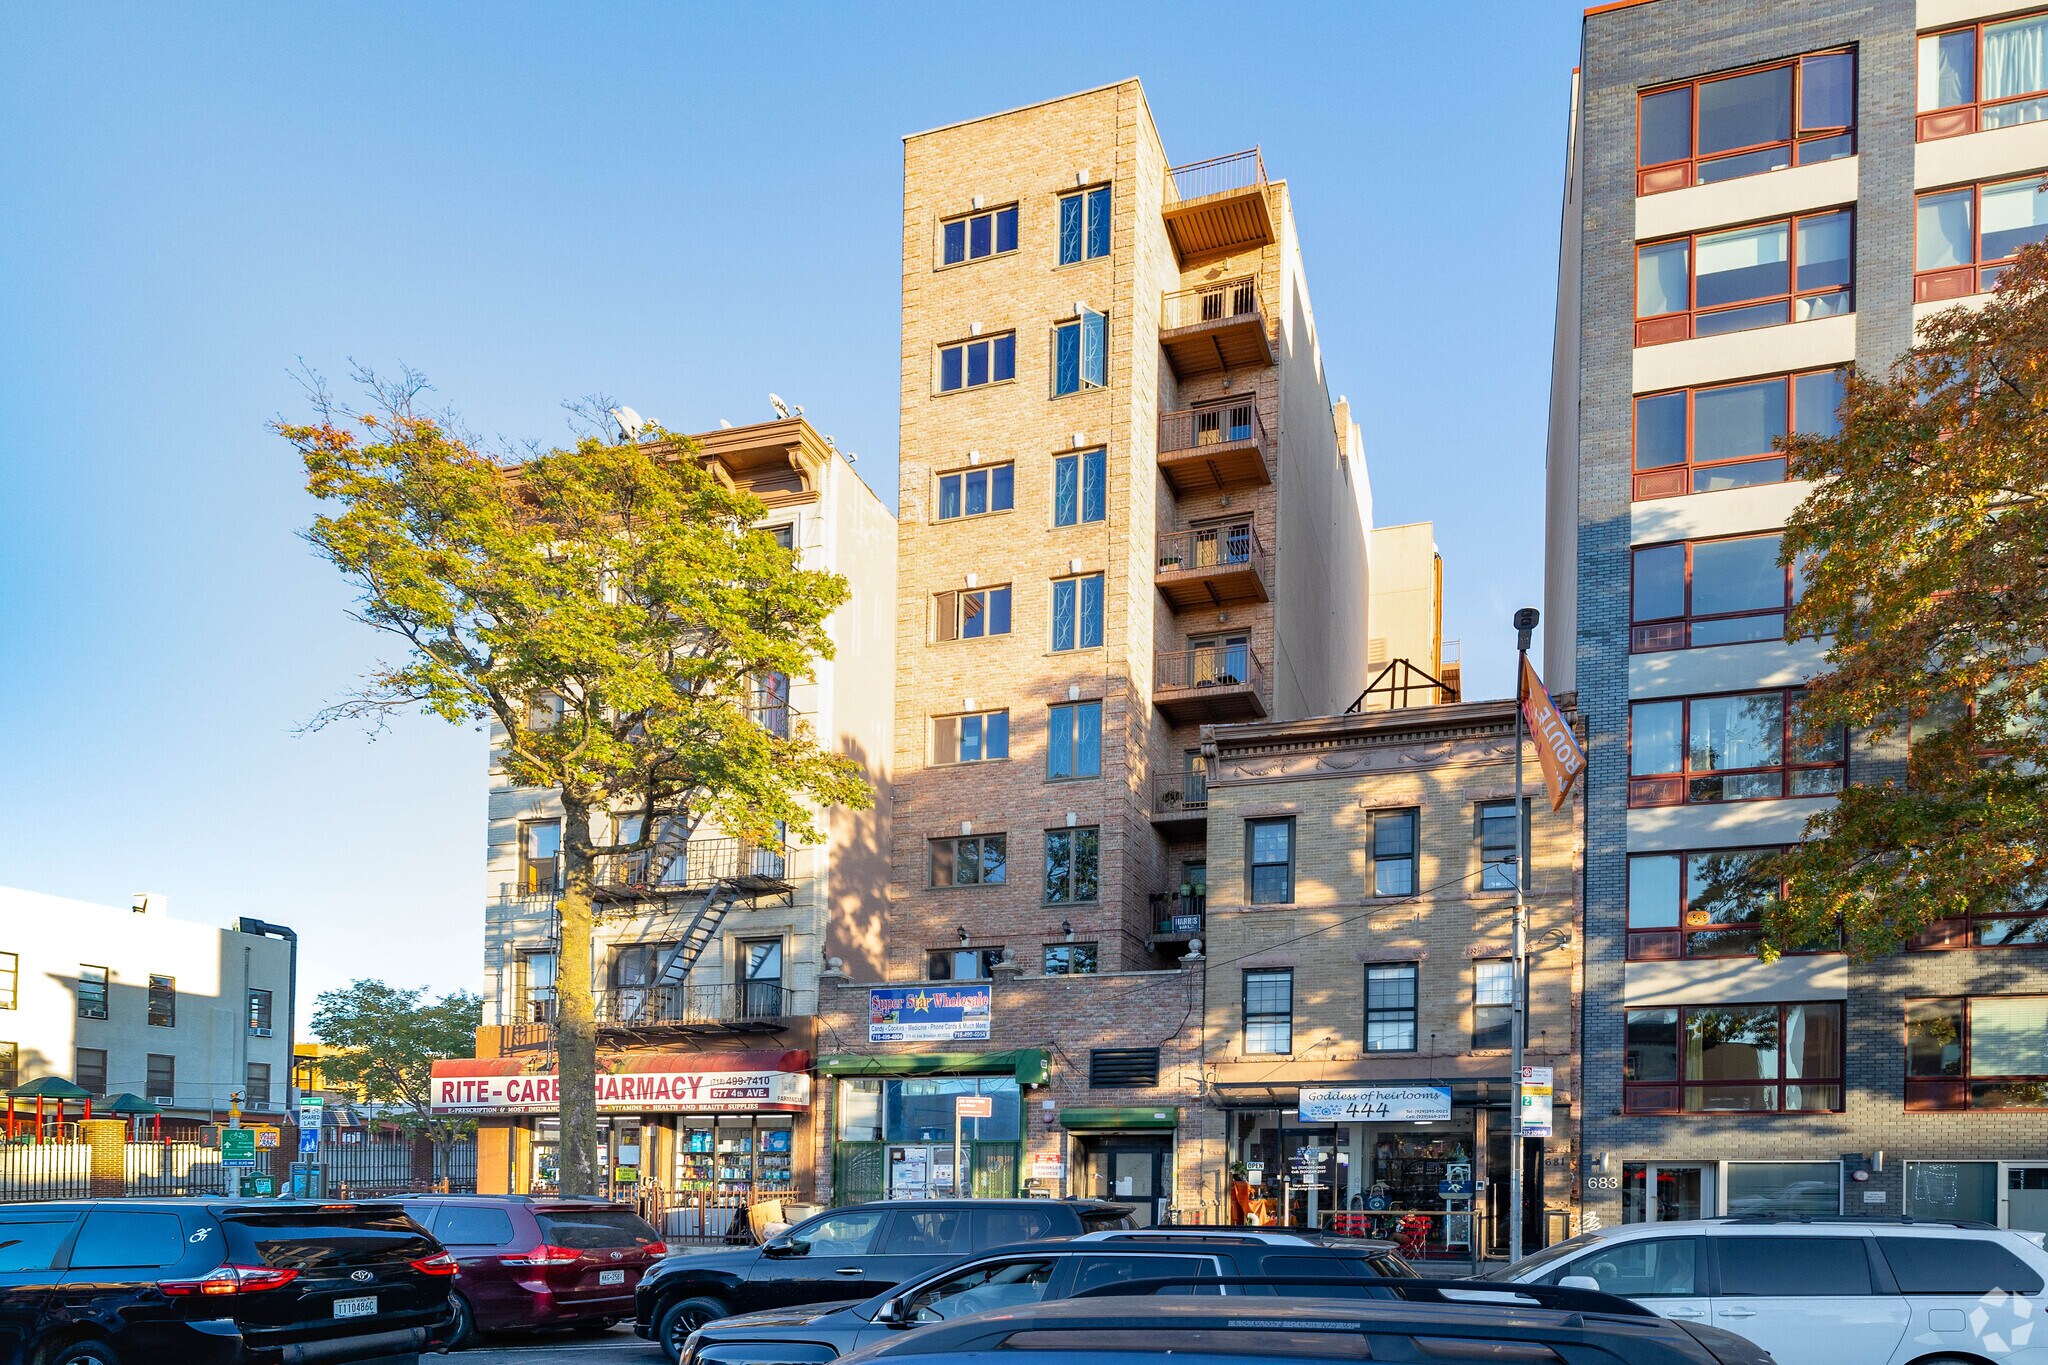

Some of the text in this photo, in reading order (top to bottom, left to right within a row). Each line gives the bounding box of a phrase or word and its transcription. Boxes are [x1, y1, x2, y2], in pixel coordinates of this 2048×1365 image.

[1534, 706, 1580, 775] ROUTE
[871, 991, 989, 1013] Super Star Wholesale
[726, 1076, 770, 1086] 499-7410
[595, 1076, 703, 1100] HARMACY
[712, 1088, 767, 1098] 677 4th AVE.
[777, 1095, 803, 1103] FARMACIA
[1308, 1090, 1442, 1102] Goddess of heirlooms
[699, 1103, 725, 1111] BEAUTY
[1346, 1102, 1390, 1118] 444
[1545, 1157, 1565, 1166] 681
[1587, 1176, 1618, 1189] 683
[338, 1301, 374, 1314] T110486C
